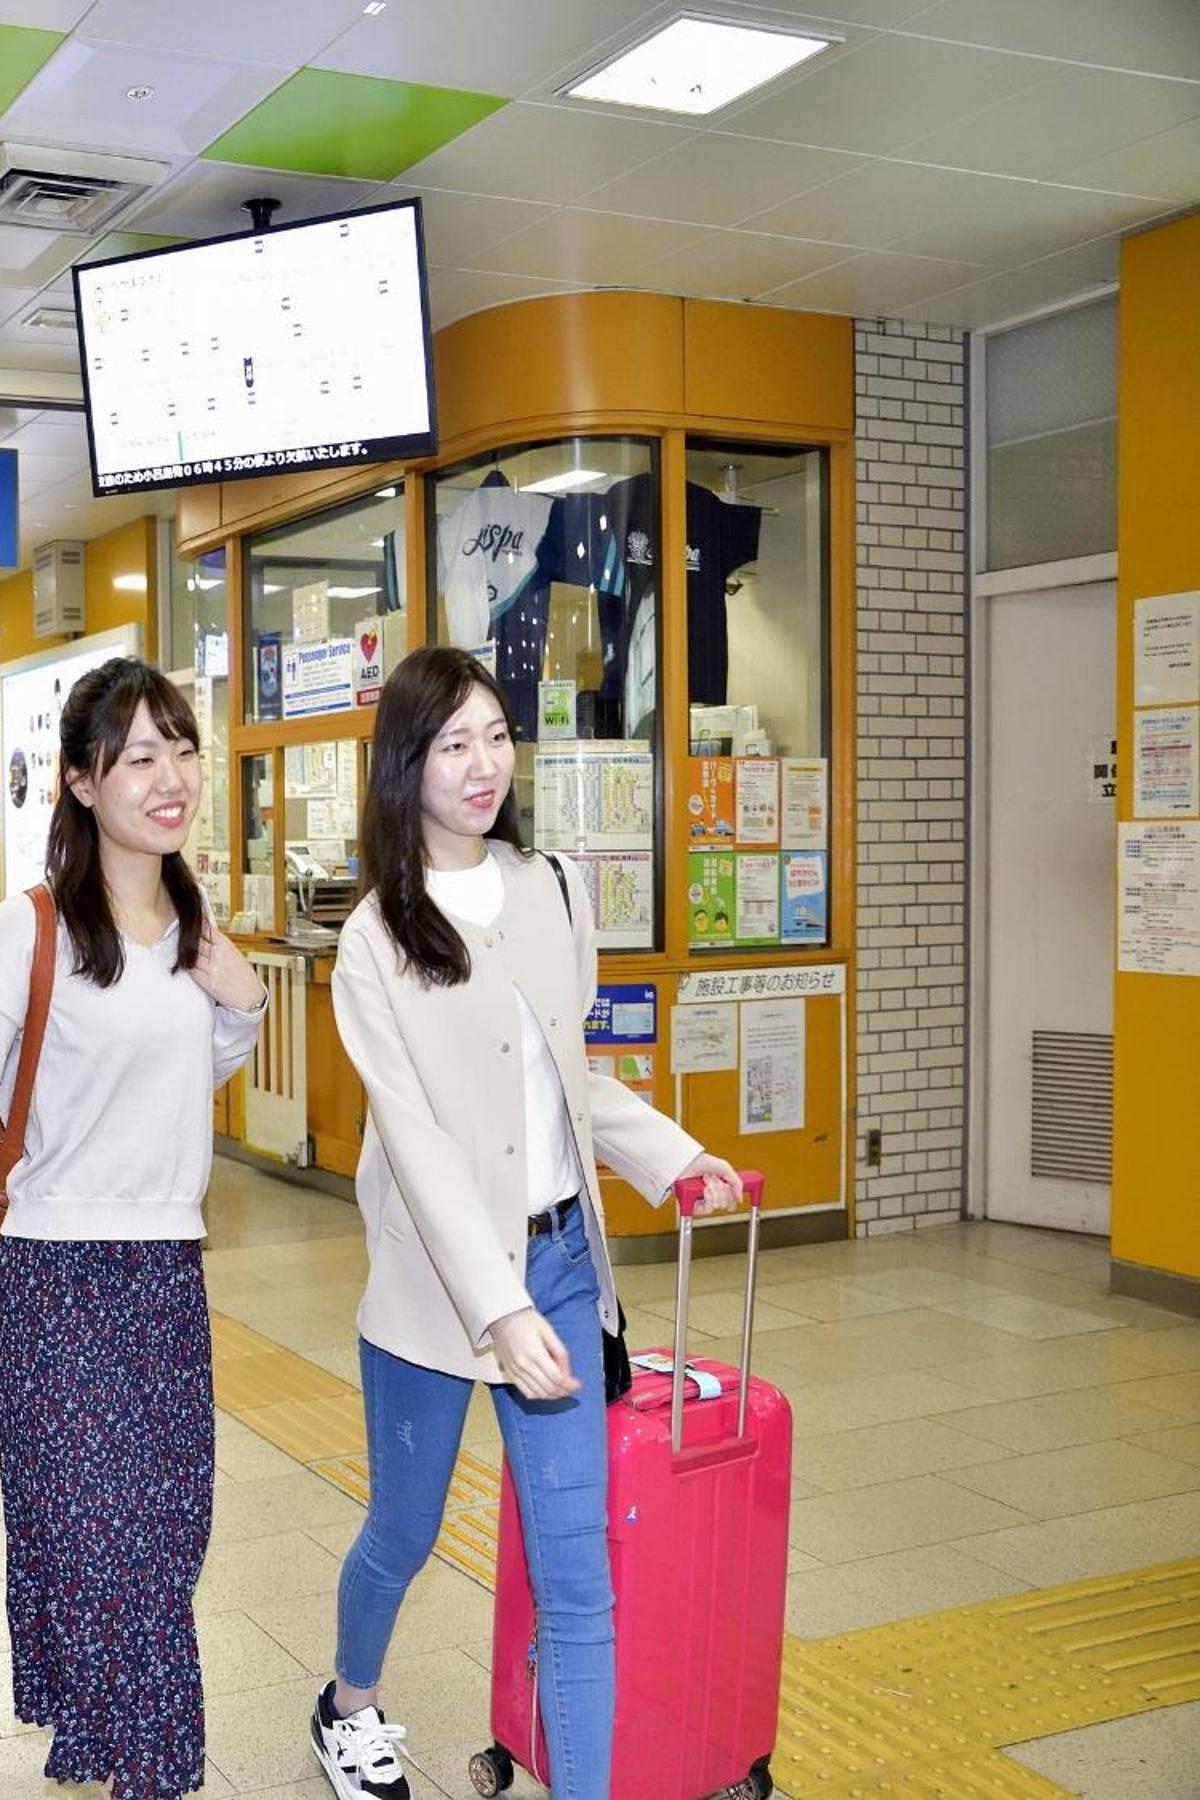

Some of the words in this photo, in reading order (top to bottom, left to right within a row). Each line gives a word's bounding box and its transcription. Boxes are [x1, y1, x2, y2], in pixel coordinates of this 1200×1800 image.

[361, 665, 380, 679] AED
[695, 970, 836, 997] 施設工事等のお知らせ
